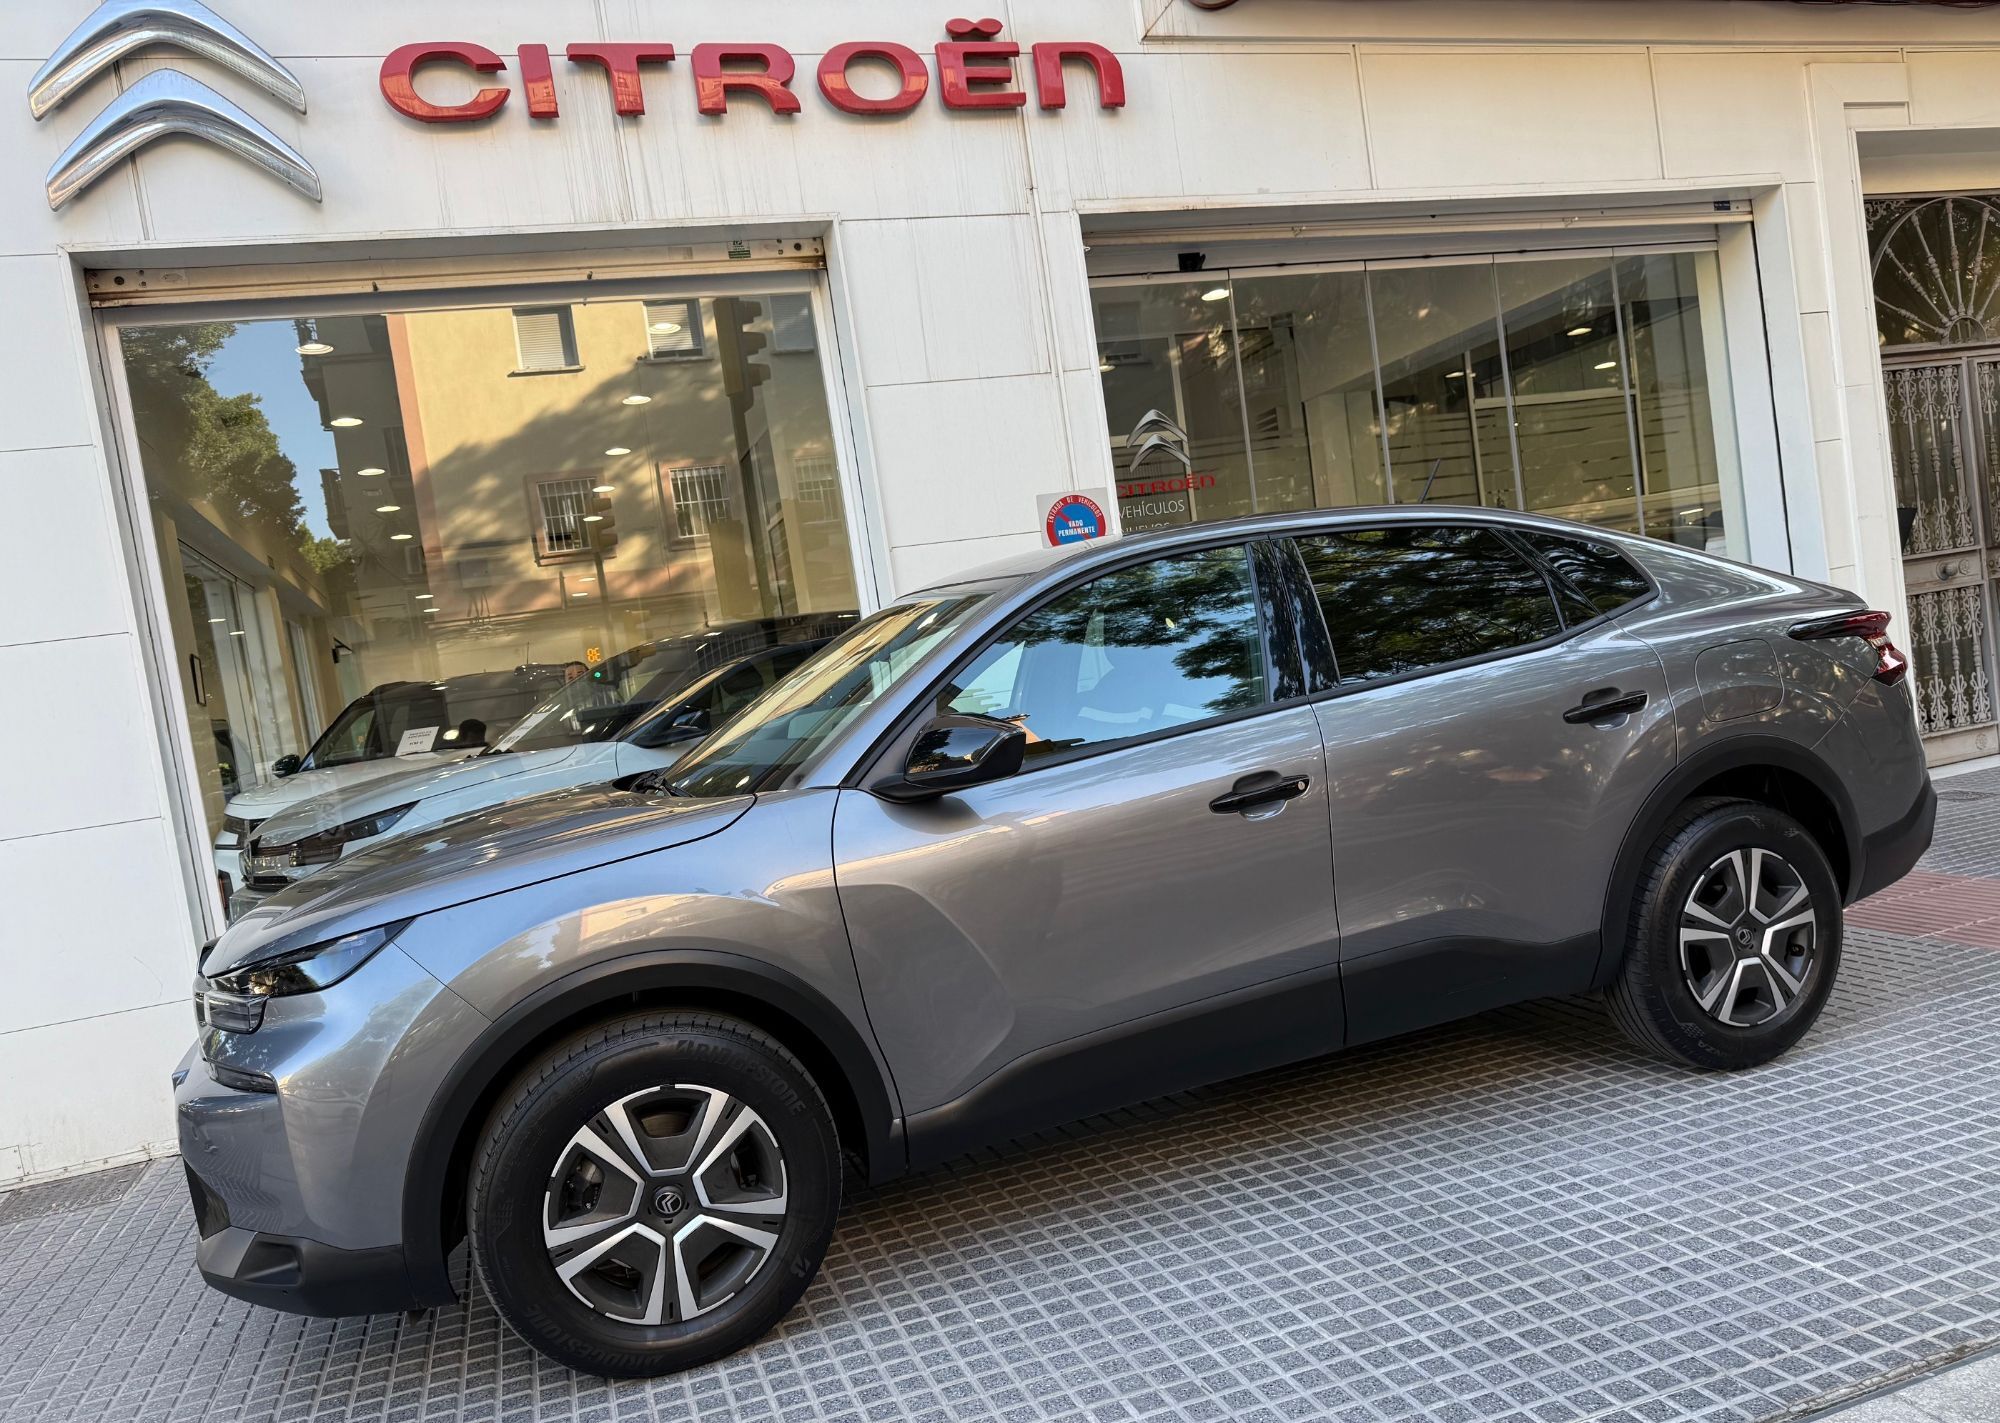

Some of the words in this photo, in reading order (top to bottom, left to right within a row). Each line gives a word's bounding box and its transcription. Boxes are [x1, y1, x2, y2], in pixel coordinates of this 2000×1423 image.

[379, 18, 1126, 123] CITROËN
[1048, 501, 1065, 523] ENTRADA
[1066, 496, 1074, 504] DE
[1057, 526, 1096, 537] PERMANENTE
[1067, 519, 1084, 528] VADO
[676, 1039, 807, 1116] BRIDGESTONE
